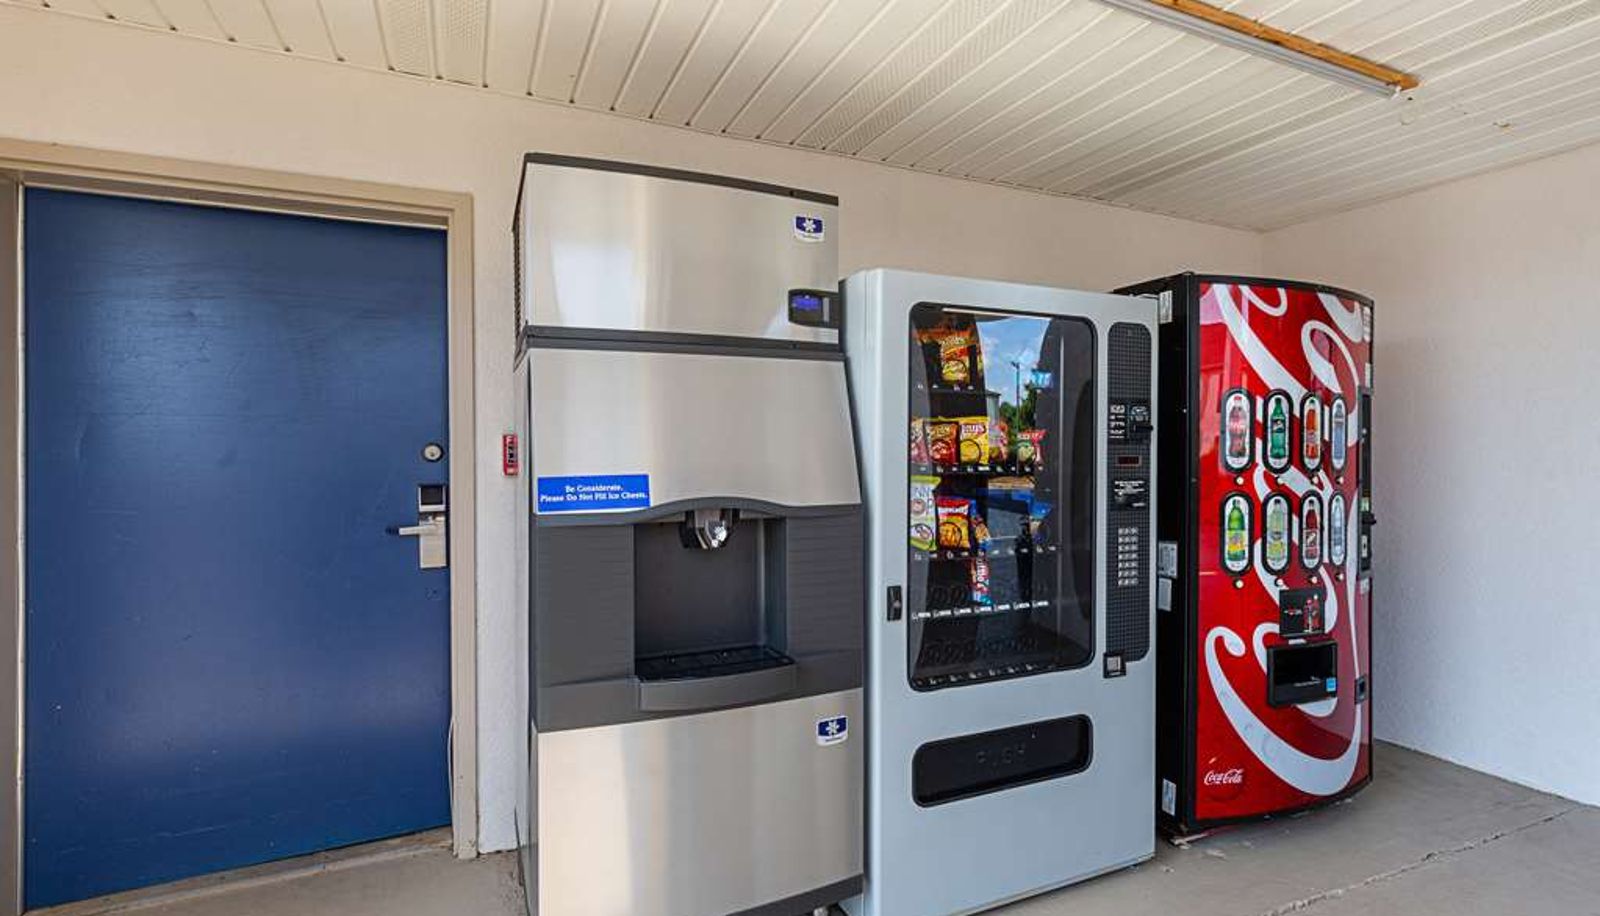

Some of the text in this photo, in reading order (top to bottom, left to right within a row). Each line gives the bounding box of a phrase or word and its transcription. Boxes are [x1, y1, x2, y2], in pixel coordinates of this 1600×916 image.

[565, 485, 576, 493] Be
[540, 494, 564, 503] Please
[565, 493, 578, 501] Do
[578, 493, 593, 501] Not
[594, 492, 608, 501] Fill
[608, 492, 620, 500] Ice
